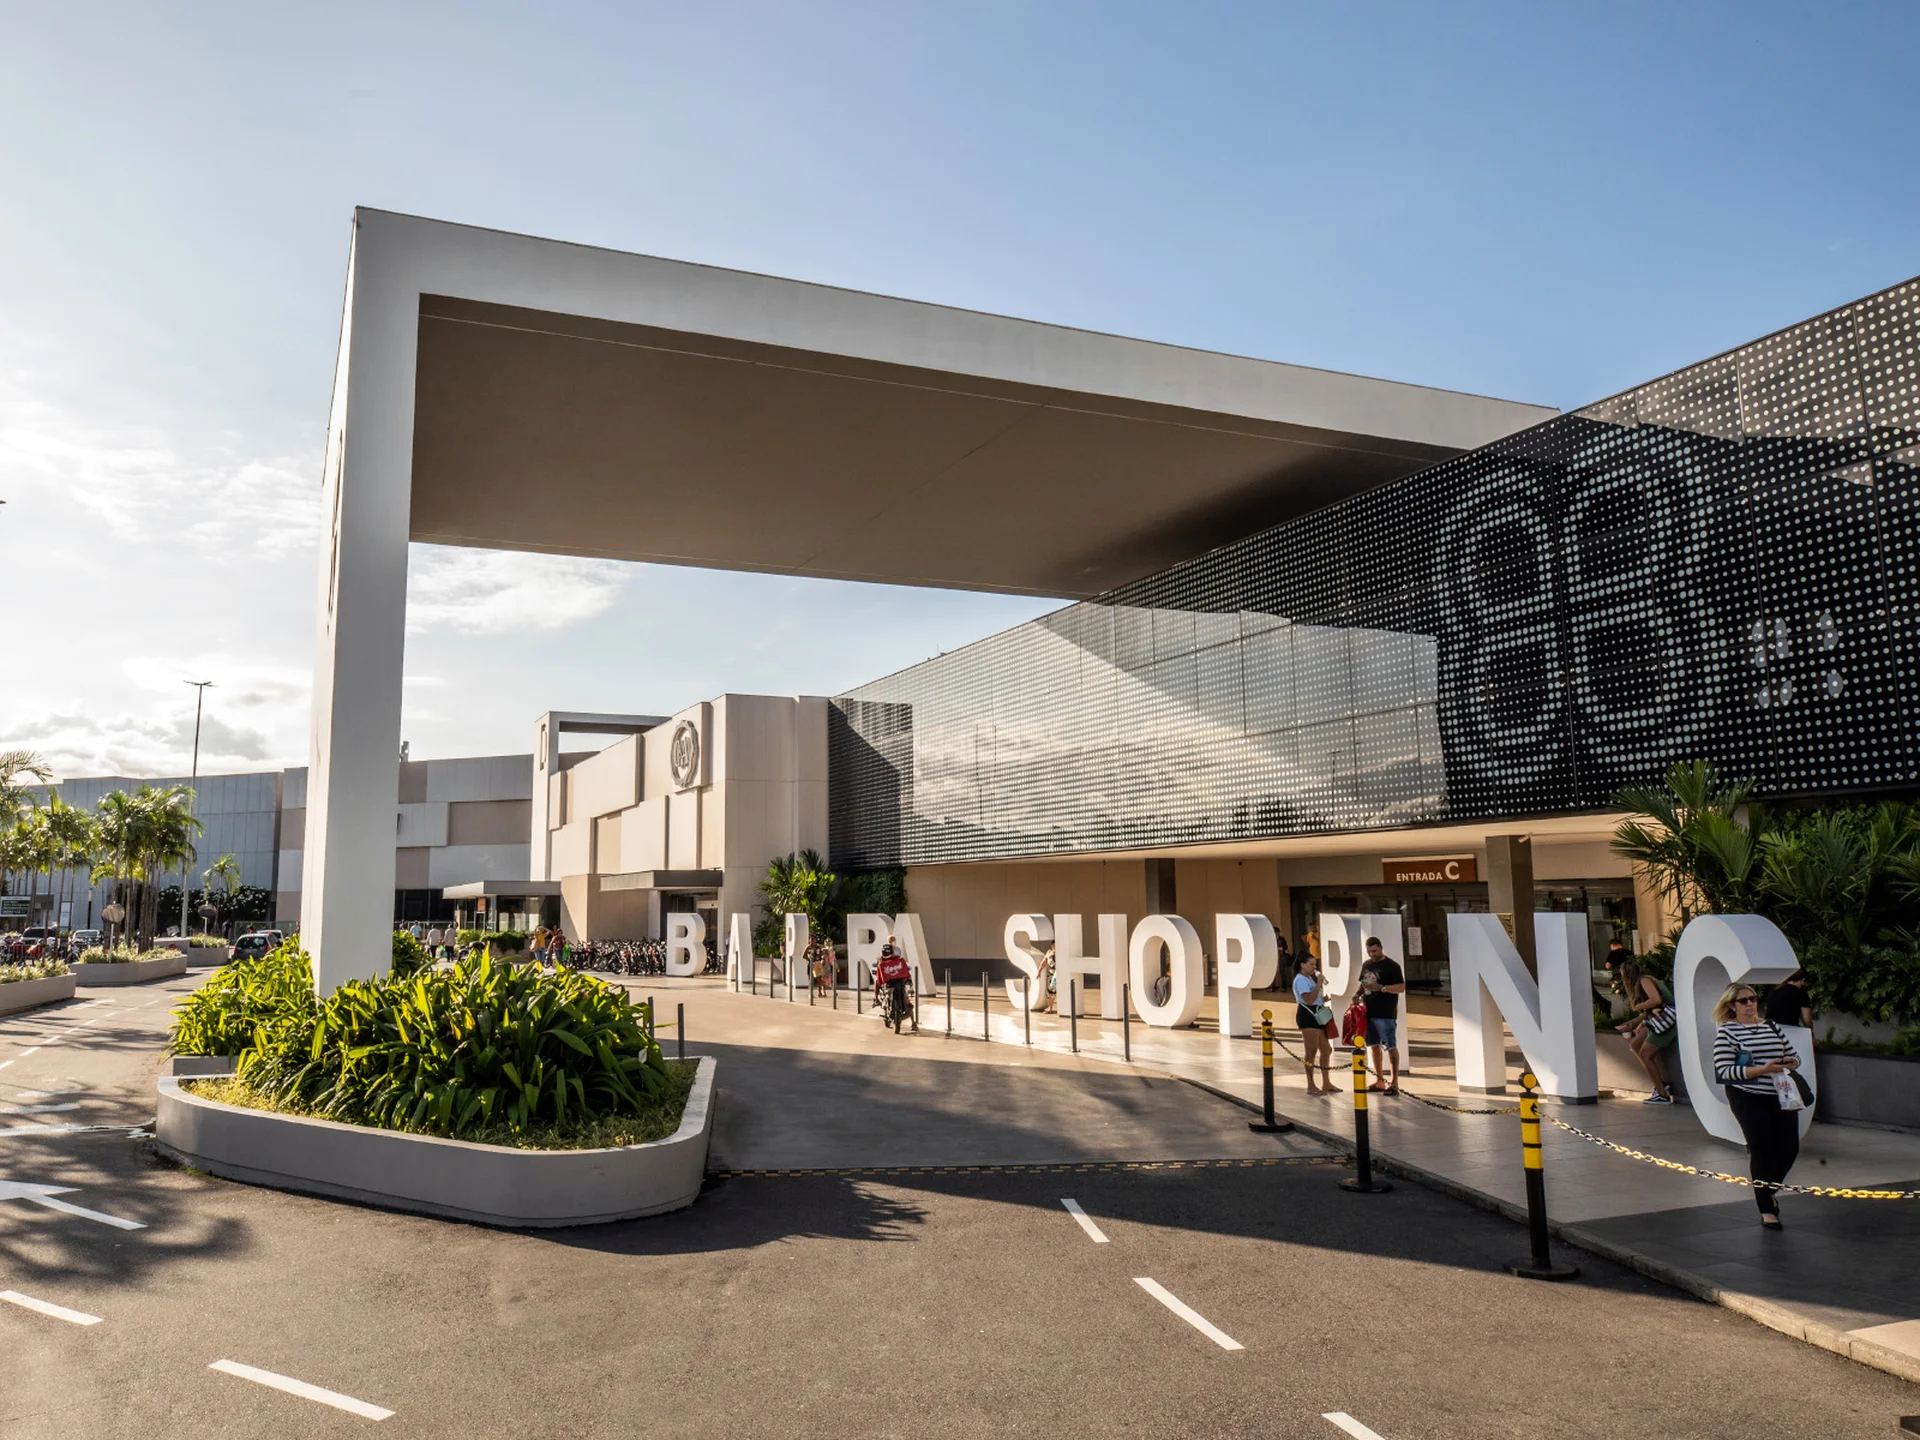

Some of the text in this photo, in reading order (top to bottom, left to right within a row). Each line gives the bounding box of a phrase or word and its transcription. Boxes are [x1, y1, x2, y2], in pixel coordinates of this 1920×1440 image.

[1396, 861, 1460, 882] ENTRADA C
[666, 912, 937, 995] BARRA
